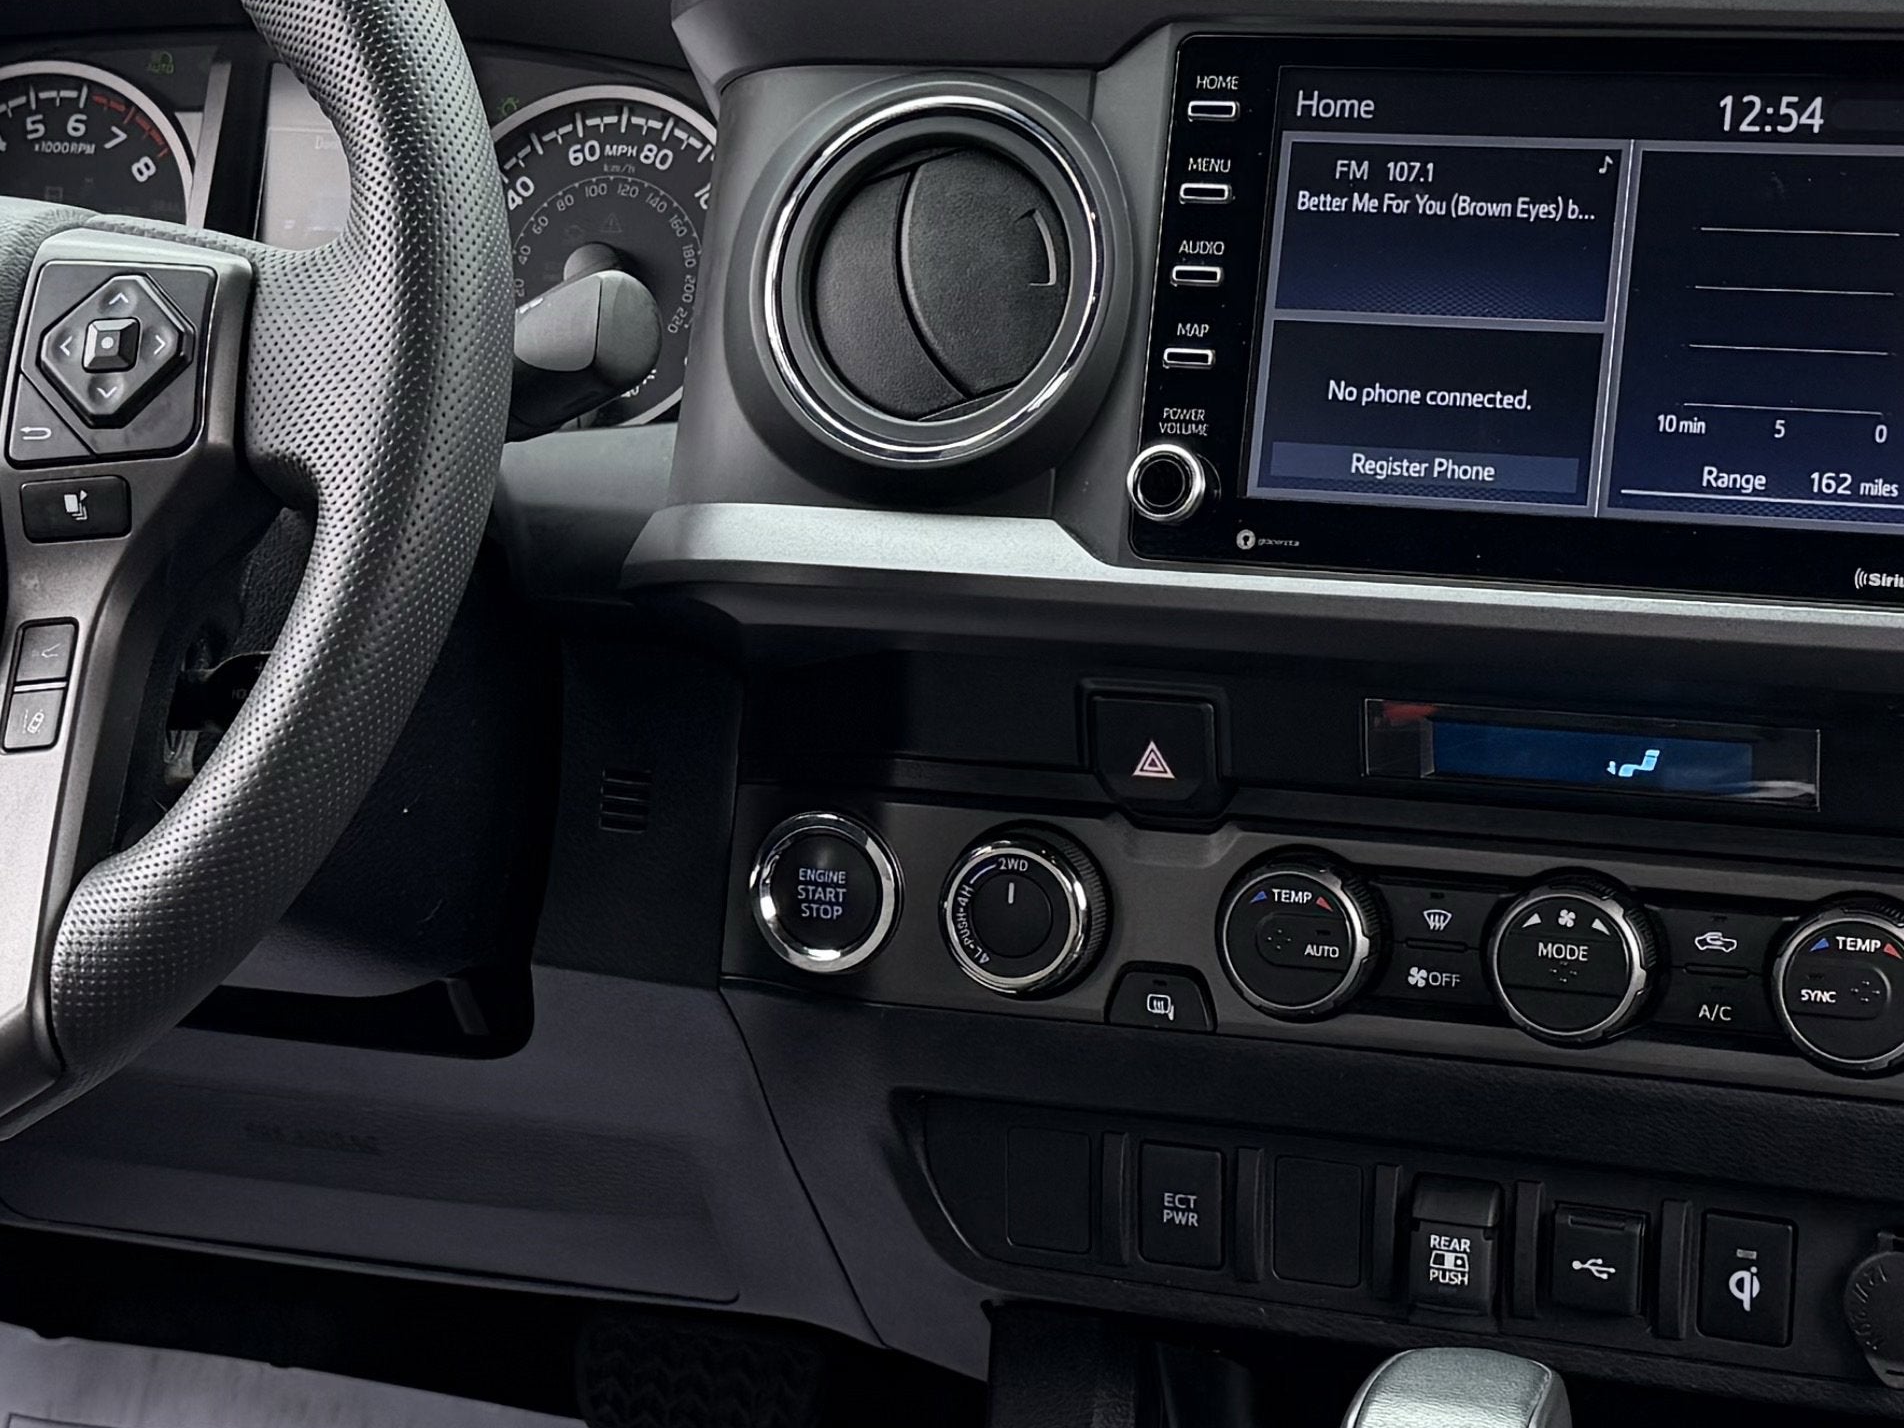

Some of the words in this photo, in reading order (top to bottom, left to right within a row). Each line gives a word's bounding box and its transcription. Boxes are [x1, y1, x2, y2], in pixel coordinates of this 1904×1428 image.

[1196, 75, 1239, 91] HOME
[1296, 89, 1375, 119] Home
[1718, 95, 1824, 134] 12:54
[25, 114, 46, 140] 5
[66, 113, 88, 138] 6
[103, 125, 128, 150] 7
[568, 139, 601, 167] 60
[604, 143, 637, 158] MPH
[640, 143, 674, 171] 80
[131, 156, 157, 183] 8
[1189, 157, 1231, 172] MENU
[1336, 160, 1369, 181] FM
[1386, 161, 1435, 182] 107.1
[506, 176, 536, 211] 40
[584, 183, 608, 197] 100
[616, 184, 640, 199] 120
[555, 193, 576, 212] 80
[645, 193, 668, 214] 140
[1297, 191, 1348, 213] Better
[1352, 193, 1379, 214] Me
[1382, 194, 1411, 214] For
[1415, 195, 1447, 217] You
[1450, 194, 1512, 219] (Brown
[1516, 197, 1563, 222] Eyes)
[1567, 199, 1596, 220] b...
[531, 215, 550, 236] 60
[668, 214, 688, 238] 160
[518, 245, 532, 265] 40
[682, 244, 696, 269] 180
[1179, 240, 1225, 255] AUDIO
[682, 275, 695, 303] 200
[667, 307, 688, 334] 220
[1177, 322, 1209, 338] MAP
[1328, 379, 1357, 403] No
[1362, 382, 1421, 406] phone
[1426, 388, 1532, 411] connected.
[1163, 408, 1205, 422] POWER
[1657, 414, 1677, 433] 10
[1679, 417, 1706, 435] min
[1159, 422, 1209, 437] VOLUME
[1774, 420, 1786, 439] 5
[1875, 424, 1888, 444] 0
[1351, 453, 1428, 479] Register
[1433, 457, 1495, 481] Phone
[1702, 466, 1766, 493] Range
[1810, 473, 1852, 495] 162
[1859, 478, 1899, 498] miles
[998, 856, 1029, 873] 2WD
[798, 867, 847, 885] ENGINE
[797, 885, 847, 904] START
[1271, 888, 1312, 904] TEMP
[800, 903, 844, 921] STOP
[1304, 943, 1339, 959] AUTO
[1537, 940, 1589, 963] MODE
[1835, 935, 1882, 954] TEMP
[1428, 971, 1462, 988] OFF
[1799, 988, 1837, 1004] SYNC
[1698, 1003, 1732, 1023] A/C
[1163, 1192, 1197, 1210] ECT
[1162, 1209, 1198, 1228] PWR
[1429, 1234, 1471, 1253] REAR
[1429, 1268, 1470, 1287] PUSH
